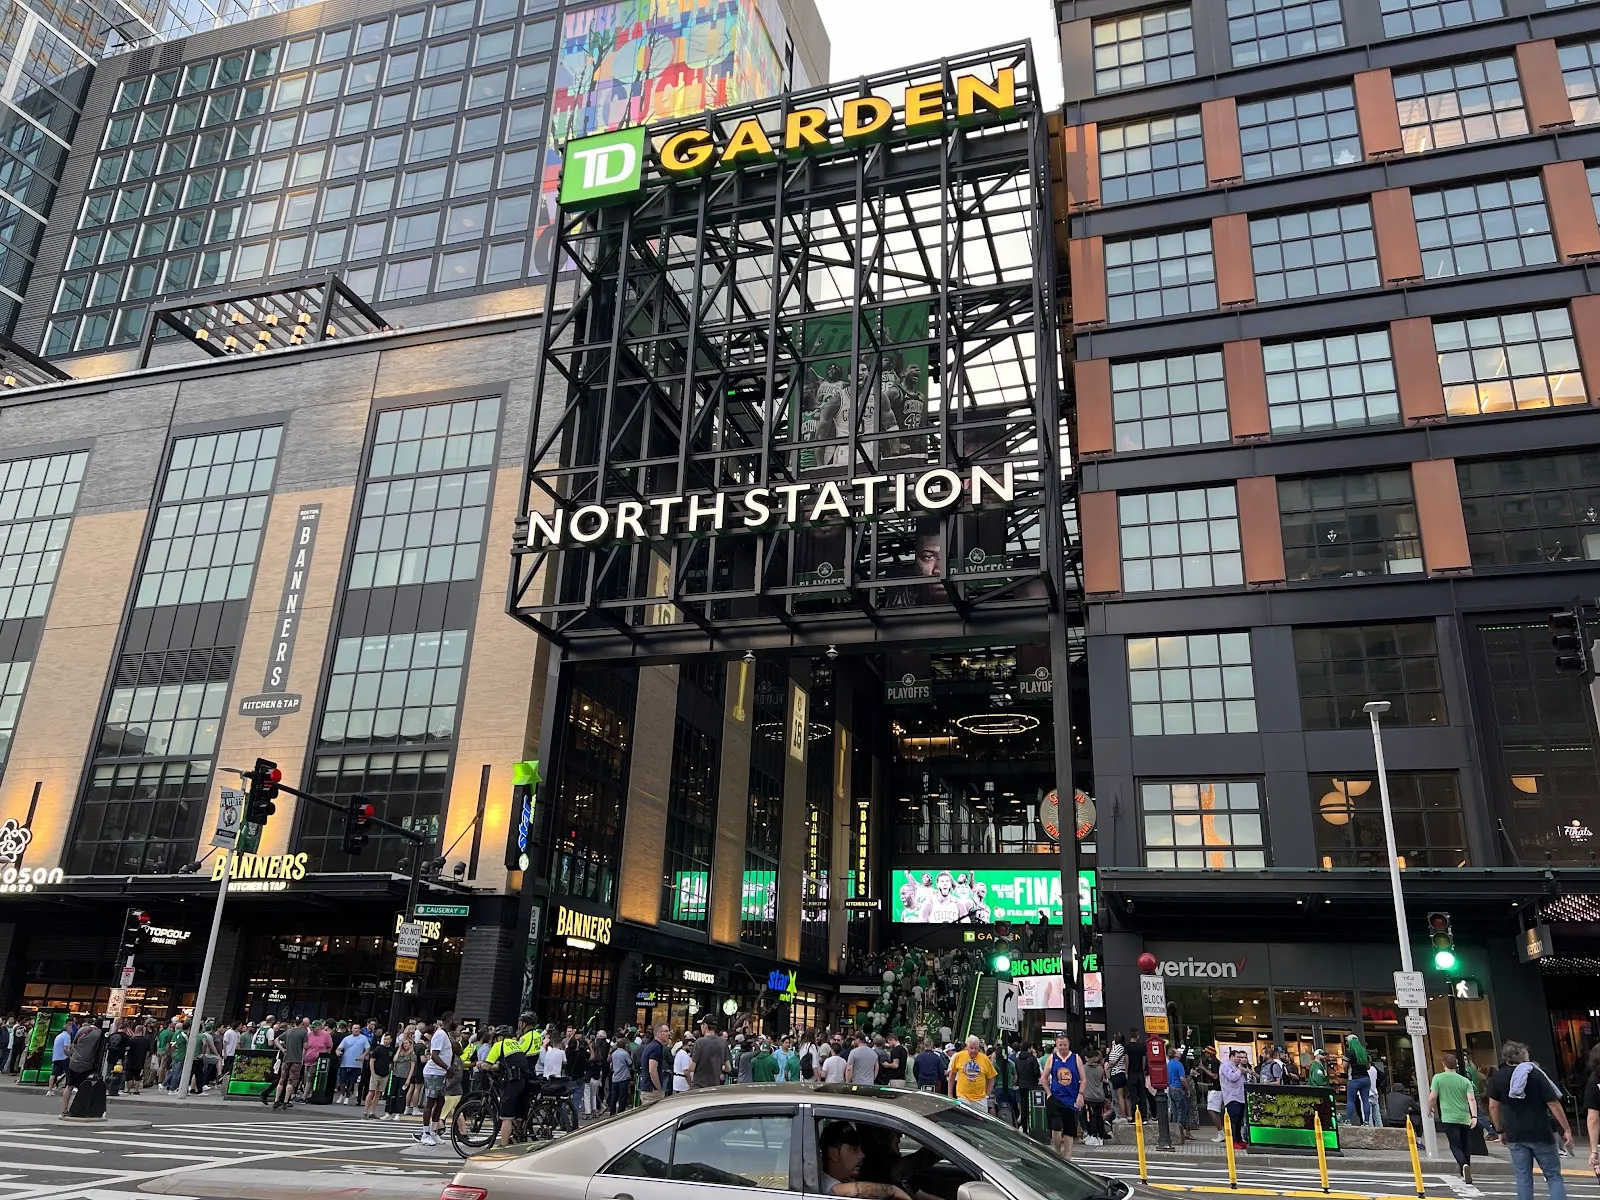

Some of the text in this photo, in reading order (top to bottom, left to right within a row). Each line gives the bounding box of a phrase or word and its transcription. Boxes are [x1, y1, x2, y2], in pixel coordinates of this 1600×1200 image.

[572, 66, 1017, 189] TD GARDEN
[525, 462, 1015, 549] NORTH STATION
[270, 526, 310, 687] BANNERS
[887, 685, 930, 700] PLAYOFFS
[242, 699, 300, 710] KITCHEN & TAP
[858, 810, 867, 896] BANNERS
[0, 866, 64, 884] osan
[210, 852, 308, 882] BANNERS
[1014, 877, 1091, 905] FINAS
[149, 926, 191, 939] TOPGOLF
[401, 927, 421, 936] DO NOT
[556, 905, 612, 945] BANNERS
[399, 937, 419, 946] BLOCK
[964, 932, 975, 942] TD
[1011, 959, 1030, 976] BIG
[1031, 956, 1061, 974] NIGH
[1155, 956, 1238, 978] verizon
[683, 969, 715, 984] STARBUCKS
[768, 969, 789, 991] star
[1143, 981, 1163, 991] DO NOT
[1143, 994, 1164, 1004] BLOCK
[1000, 1016, 1016, 1027] ONLY
[256, 1034, 266, 1045] 33
